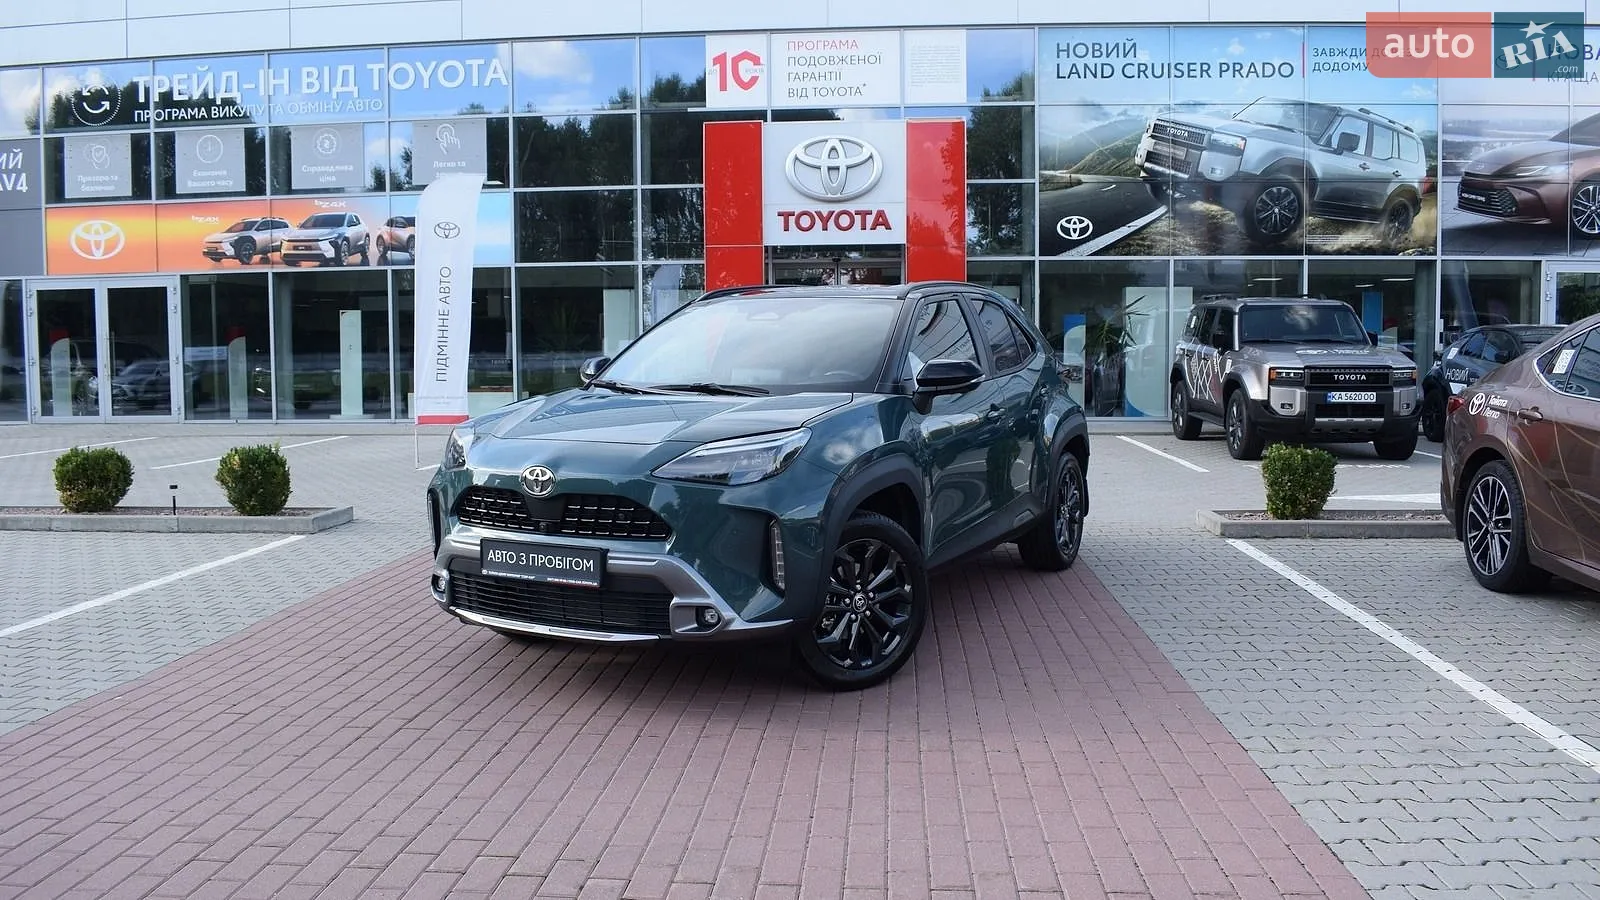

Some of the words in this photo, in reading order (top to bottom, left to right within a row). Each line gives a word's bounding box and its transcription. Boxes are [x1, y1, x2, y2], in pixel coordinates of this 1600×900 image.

[787, 39, 859, 51] ПРОГРАМА
[1056, 38, 1138, 59] НОВИЙ
[1312, 47, 1367, 59] ЗАВЖДИ
[787, 51, 882, 67] ПОДОВЖЕНОЇ
[1312, 61, 1370, 73] ДОДОМУ
[1056, 62, 1115, 79] LAND
[1121, 62, 1212, 79] CRUISER
[1218, 61, 1295, 78] PRADO
[132, 65, 290, 105] ТРЕЙД-ІН
[302, 64, 360, 99] ВІД
[366, 58, 510, 91] TOYOTA
[787, 87, 809, 99] ВІД
[134, 107, 208, 122] ПРОГРАМА
[211, 104, 265, 119] ВИКУПУ
[269, 103, 283, 115] ТА
[287, 100, 343, 114] ОБМІНУ
[346, 98, 383, 112] АВТО
[777, 209, 892, 232] TOYOTA
[439, 265, 452, 305] АВТО
[435, 309, 451, 383] ПІДМІННЕ
[487, 549, 517, 564] АВТО
[519, 552, 527, 565] З
[529, 553, 594, 572] ПРОБІГОМ
